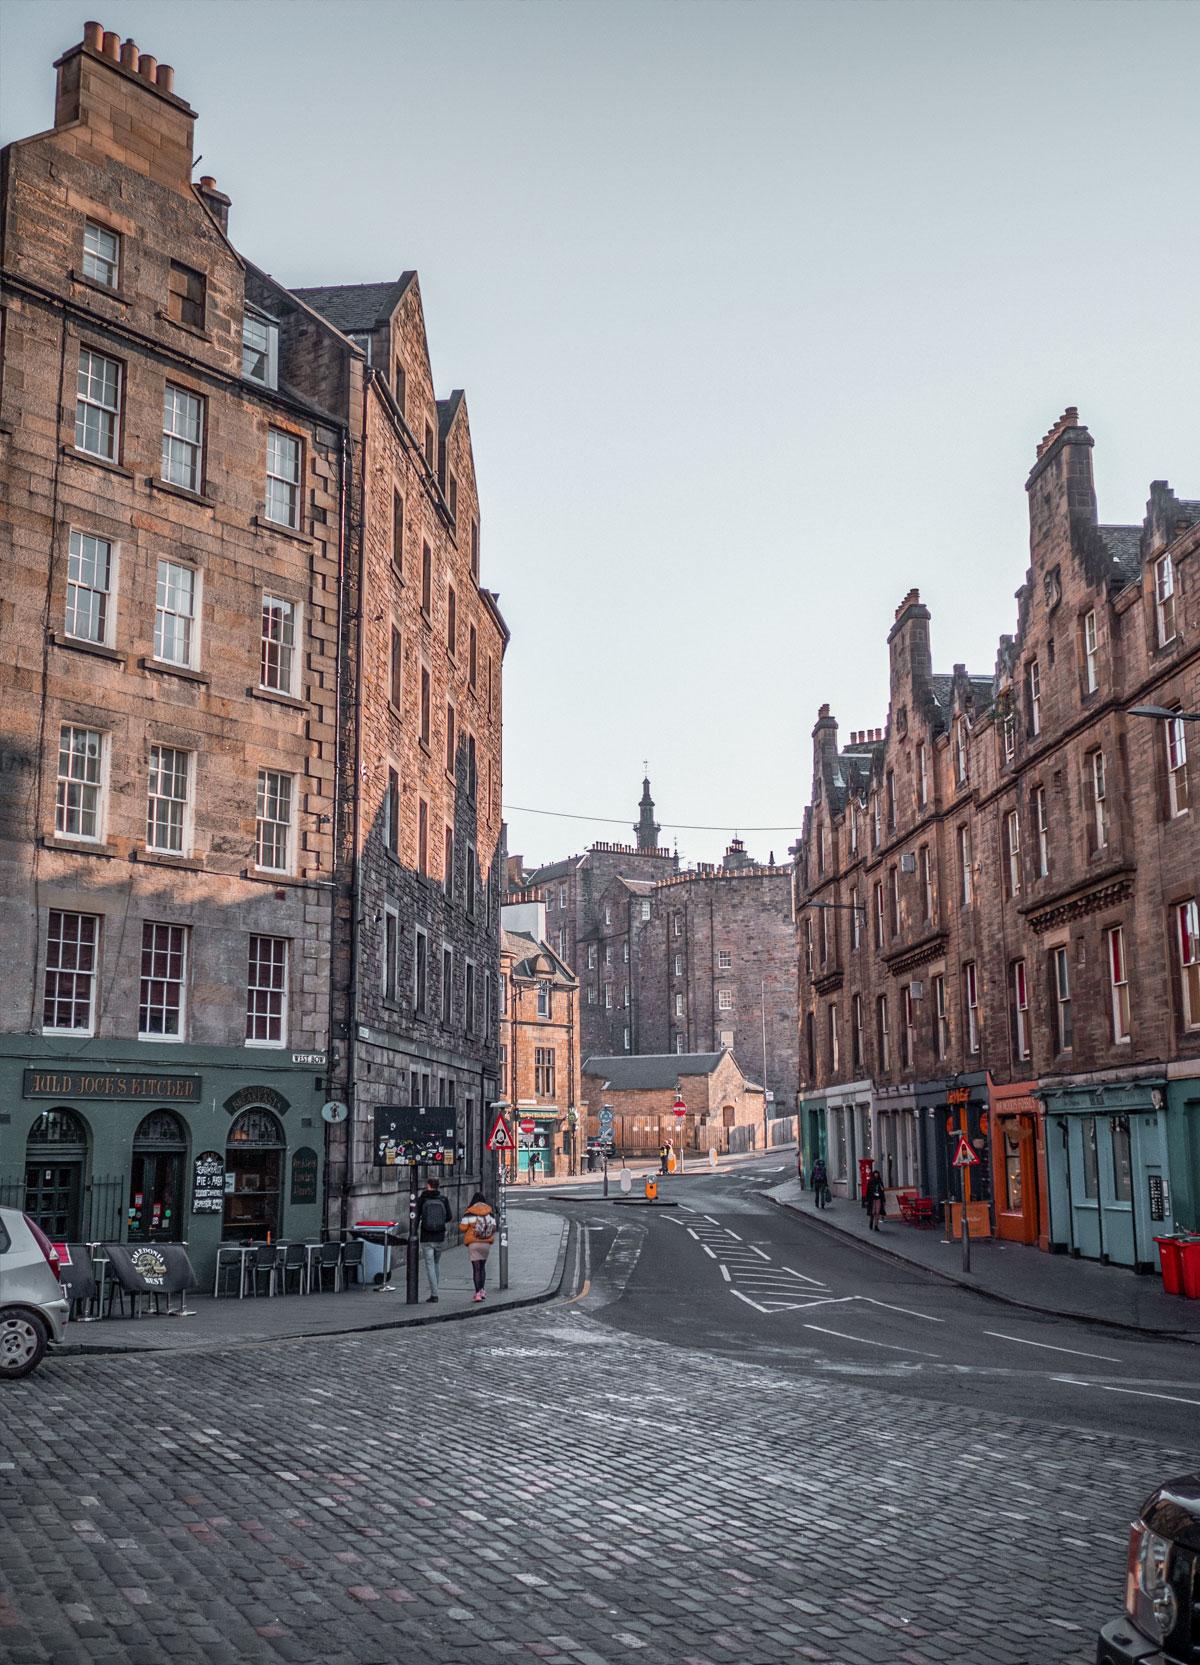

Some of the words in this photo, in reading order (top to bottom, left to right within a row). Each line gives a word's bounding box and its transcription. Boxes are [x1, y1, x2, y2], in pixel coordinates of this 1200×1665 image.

[294, 1055, 310, 1063] WEST
[311, 1056, 325, 1064] BOW
[31, 1074, 72, 1093] AULD
[76, 1076, 127, 1095] JOCK'S
[131, 1078, 194, 1097] KITCHEN
[232, 1093, 280, 1110] BREAKFASTS
[197, 1176, 206, 1186] PIE
[131, 1248, 164, 1264] CALEDONIA
[144, 1277, 164, 1285] BEST
